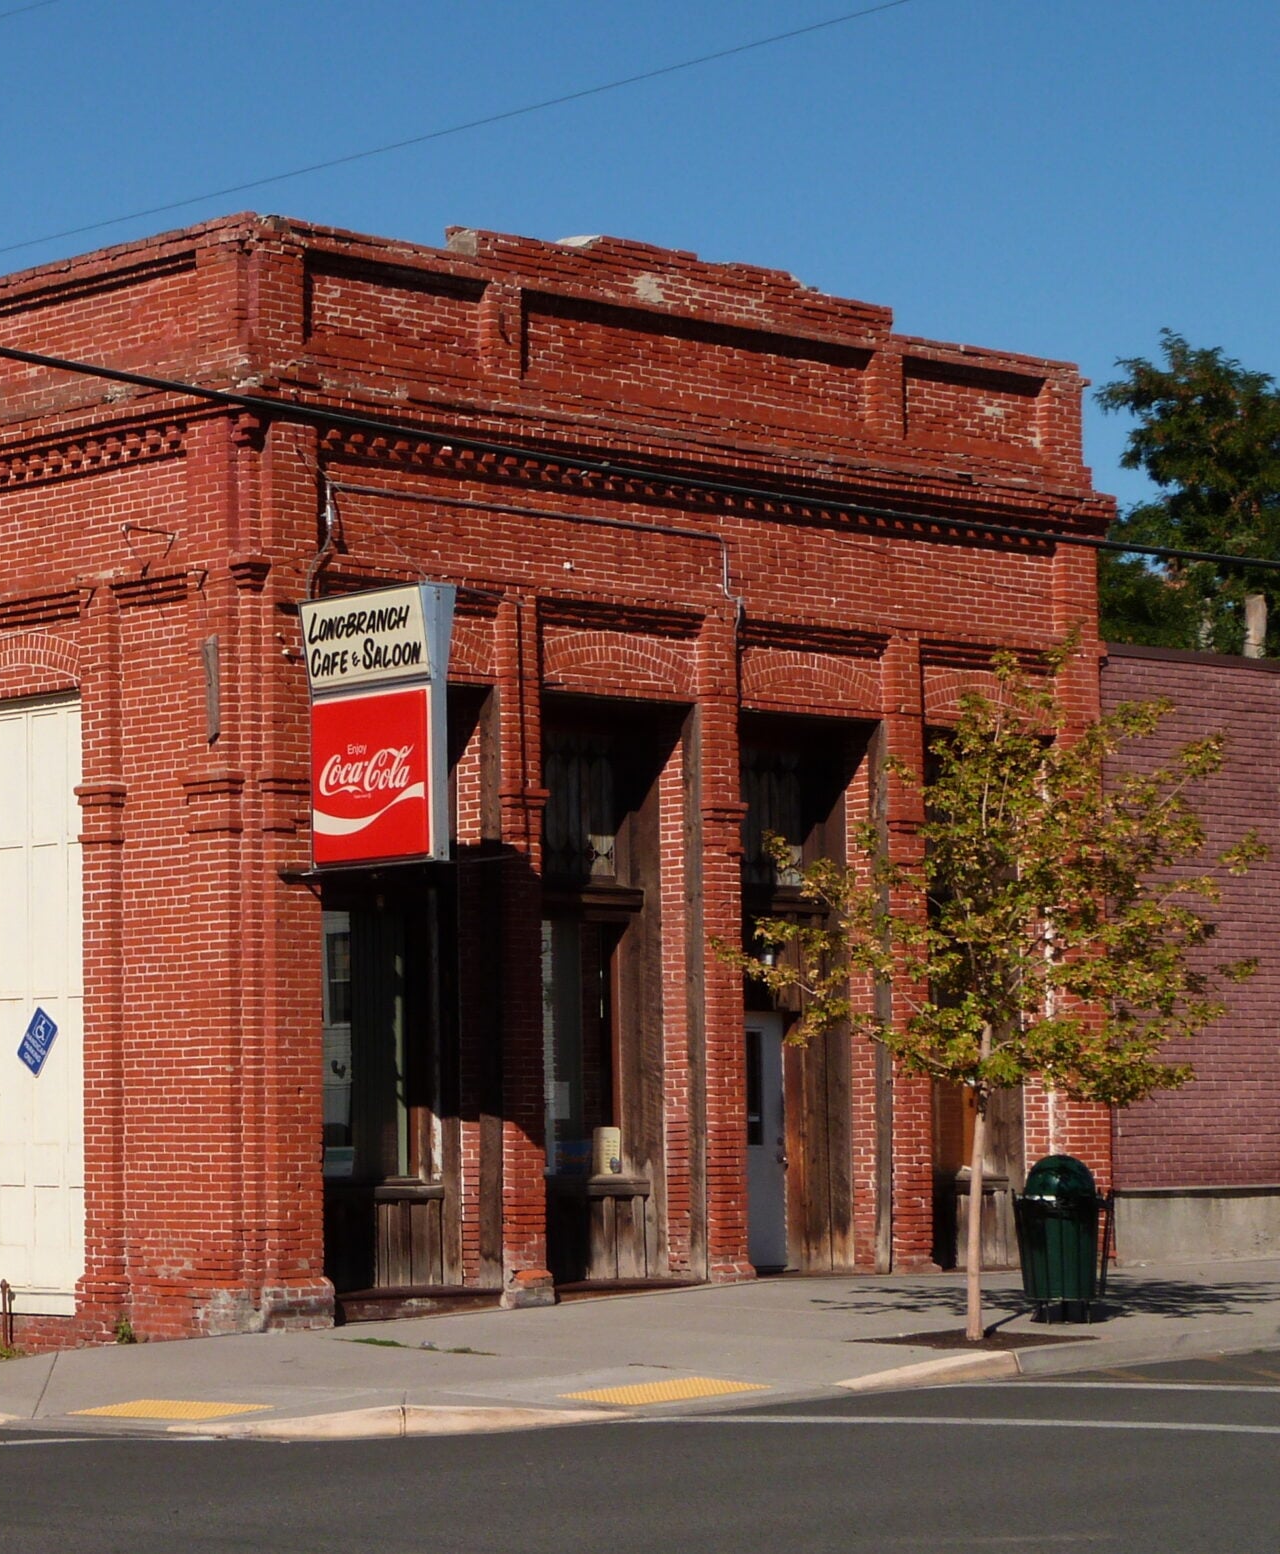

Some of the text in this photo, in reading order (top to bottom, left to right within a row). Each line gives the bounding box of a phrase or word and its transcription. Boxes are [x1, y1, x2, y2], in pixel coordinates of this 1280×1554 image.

[308, 605, 410, 645] LONGBRANCH
[311, 638, 422, 678] CAFE & SALOON
[347, 744, 367, 755] Enjoy
[320, 745, 414, 796] Coca-Cola
